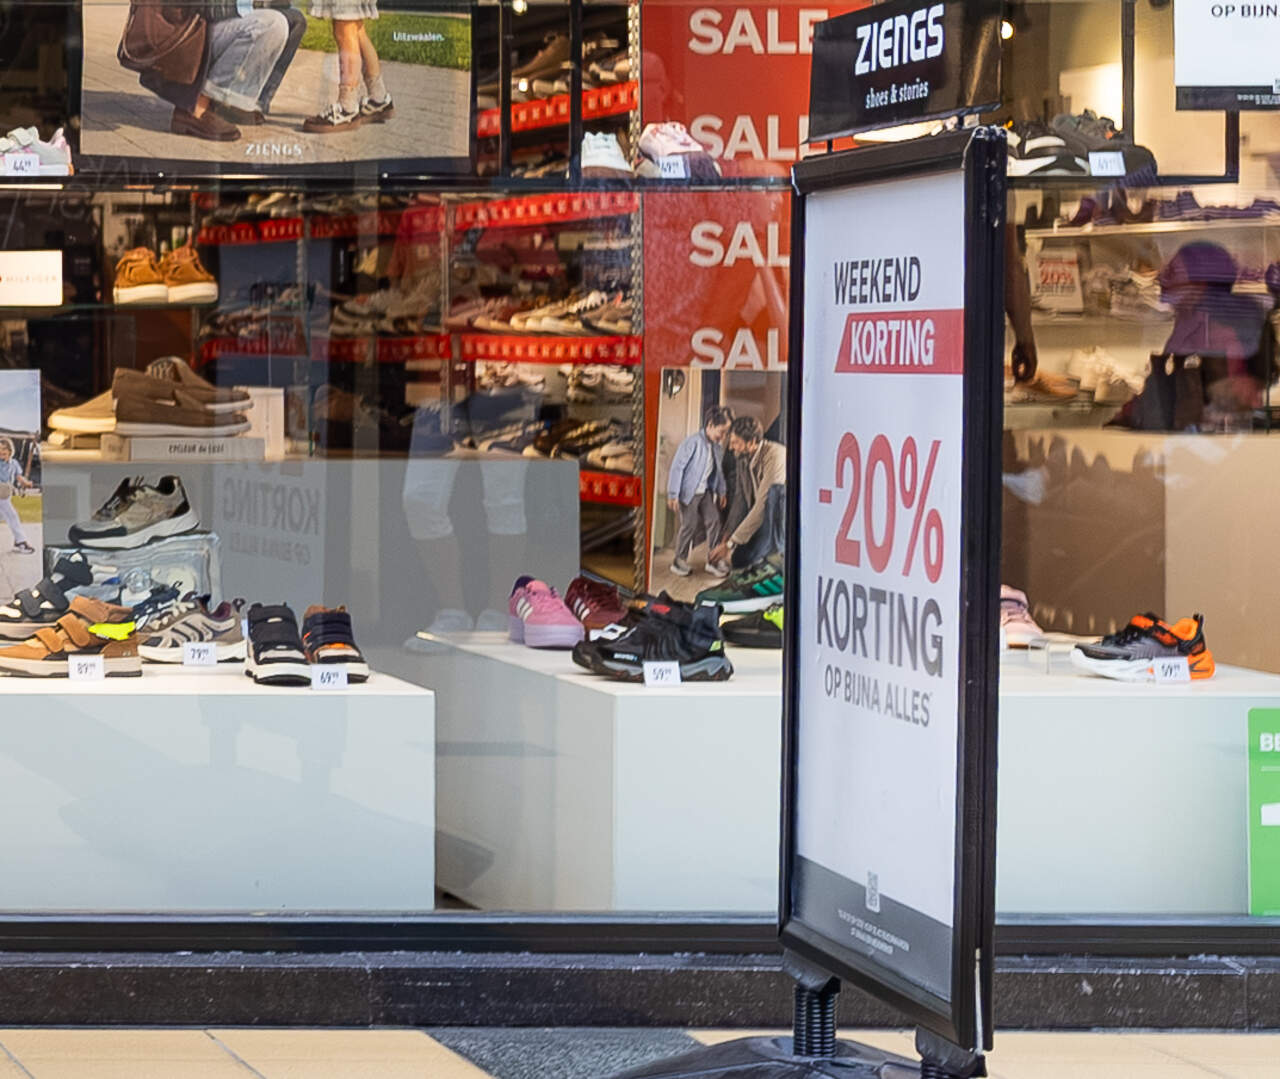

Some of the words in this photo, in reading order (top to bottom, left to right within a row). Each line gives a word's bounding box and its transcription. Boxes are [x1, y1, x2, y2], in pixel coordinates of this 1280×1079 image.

[689, 9, 829, 54] SALE
[1211, 4, 1235, 17] OP
[1241, 4, 1280, 17] BIJN
[855, 3, 944, 75] ZIENGS
[865, 88, 888, 109] shoes
[890, 84, 898, 103] &
[899, 78, 929, 102] stories
[244, 142, 303, 157] ZIENGS
[834, 256, 921, 305] WEEKEND
[850, 318, 935, 365] KORTING
[819, 432, 944, 583] -20%
[817, 575, 943, 677] KORTING
[825, 664, 842, 697] OP
[844, 671, 881, 714] BIJNA
